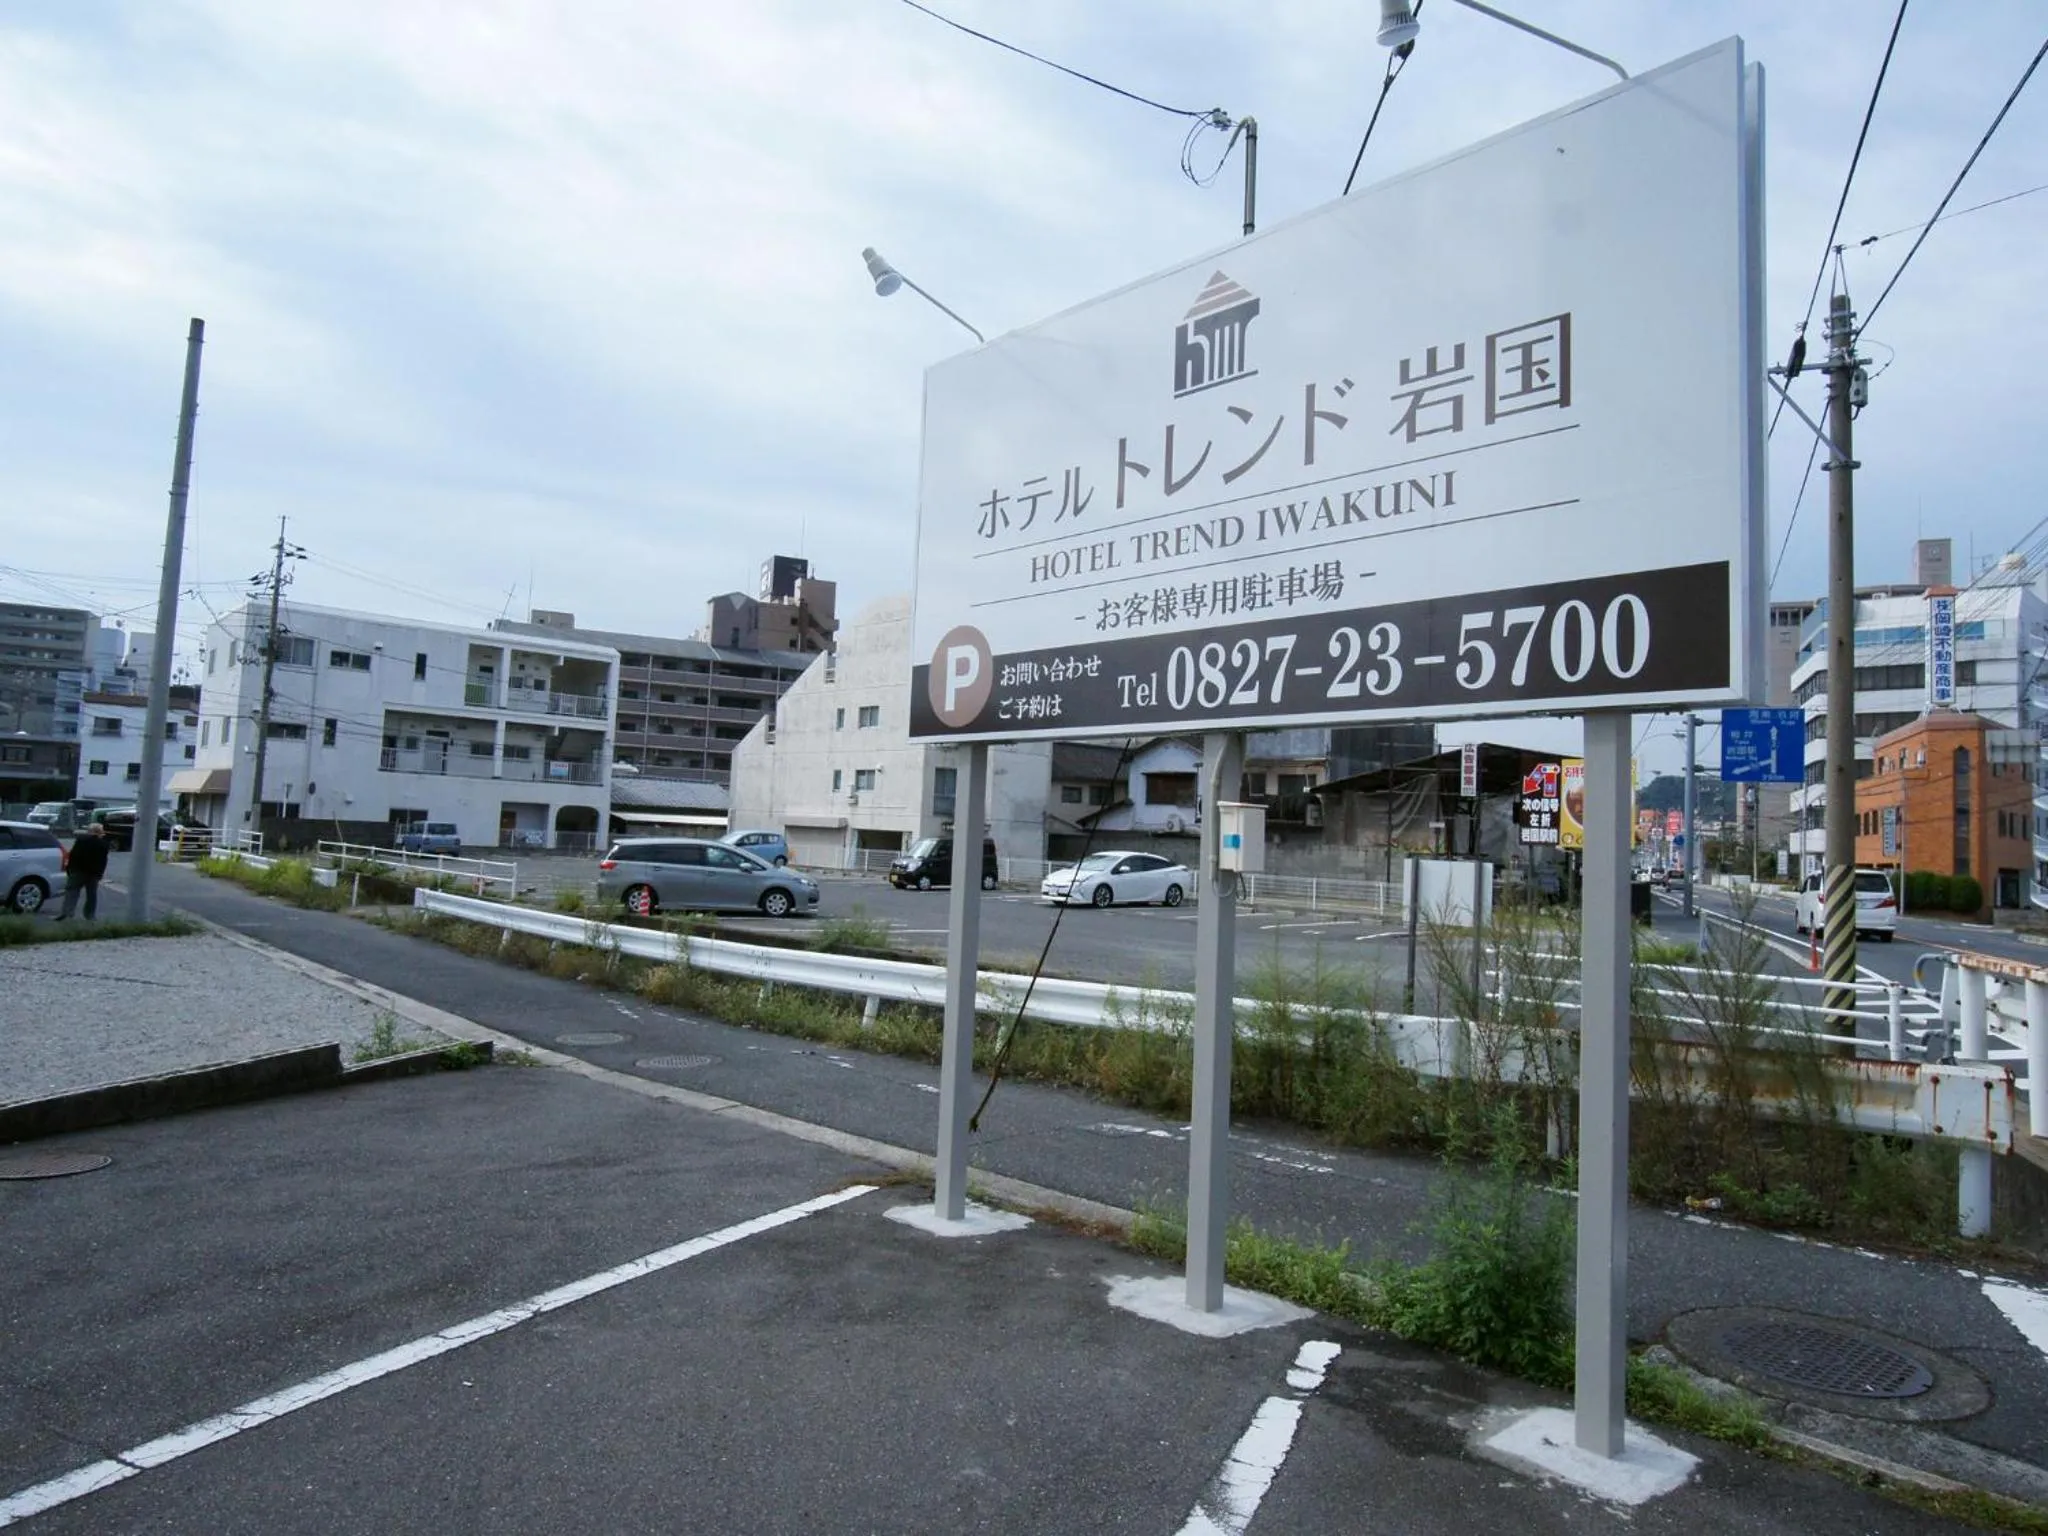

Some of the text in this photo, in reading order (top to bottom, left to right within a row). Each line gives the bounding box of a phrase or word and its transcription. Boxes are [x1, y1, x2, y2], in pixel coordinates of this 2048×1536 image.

[1030, 470, 1458, 583] HOTEL TREND IWAKUNI
[999, 654, 1102, 687] お問い合わせ
[1118, 593, 1651, 711] Tel 0827-23-5700
[944, 644, 980, 712] P
[998, 694, 1063, 720] ご予約は
[1522, 798, 1559, 812] 次の信号
